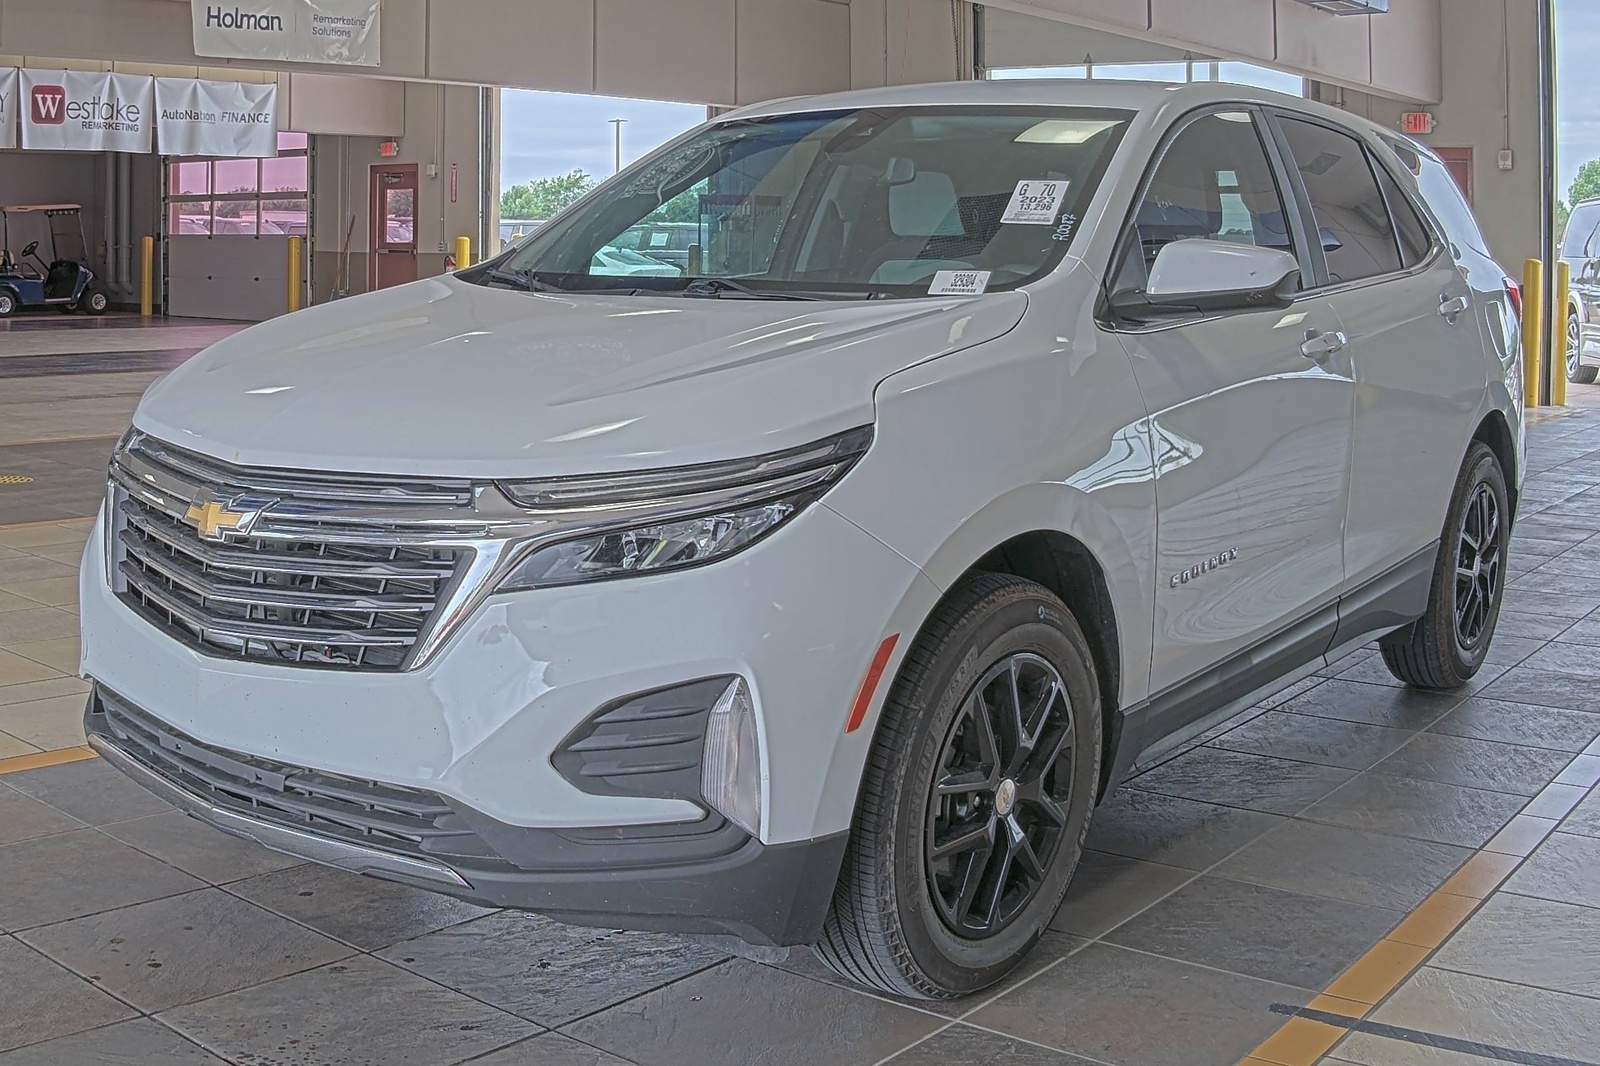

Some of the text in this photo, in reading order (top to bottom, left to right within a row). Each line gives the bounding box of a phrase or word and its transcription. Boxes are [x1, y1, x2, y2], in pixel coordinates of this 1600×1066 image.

[206, 7, 283, 32] Holman
[313, 14, 366, 29] Remarketing
[312, 27, 351, 38] Solutions
[34, 92, 140, 122] Westlake
[161, 109, 270, 124] AutoNation FINANCE
[1406, 114, 1427, 131] EXIT
[81, 121, 139, 132] REMARKETING
[1018, 184, 1056, 196] G 70
[1019, 196, 1056, 204] 2023
[1019, 203, 1053, 212] 13,296
[1170, 547, 1239, 588] EQUINOX
